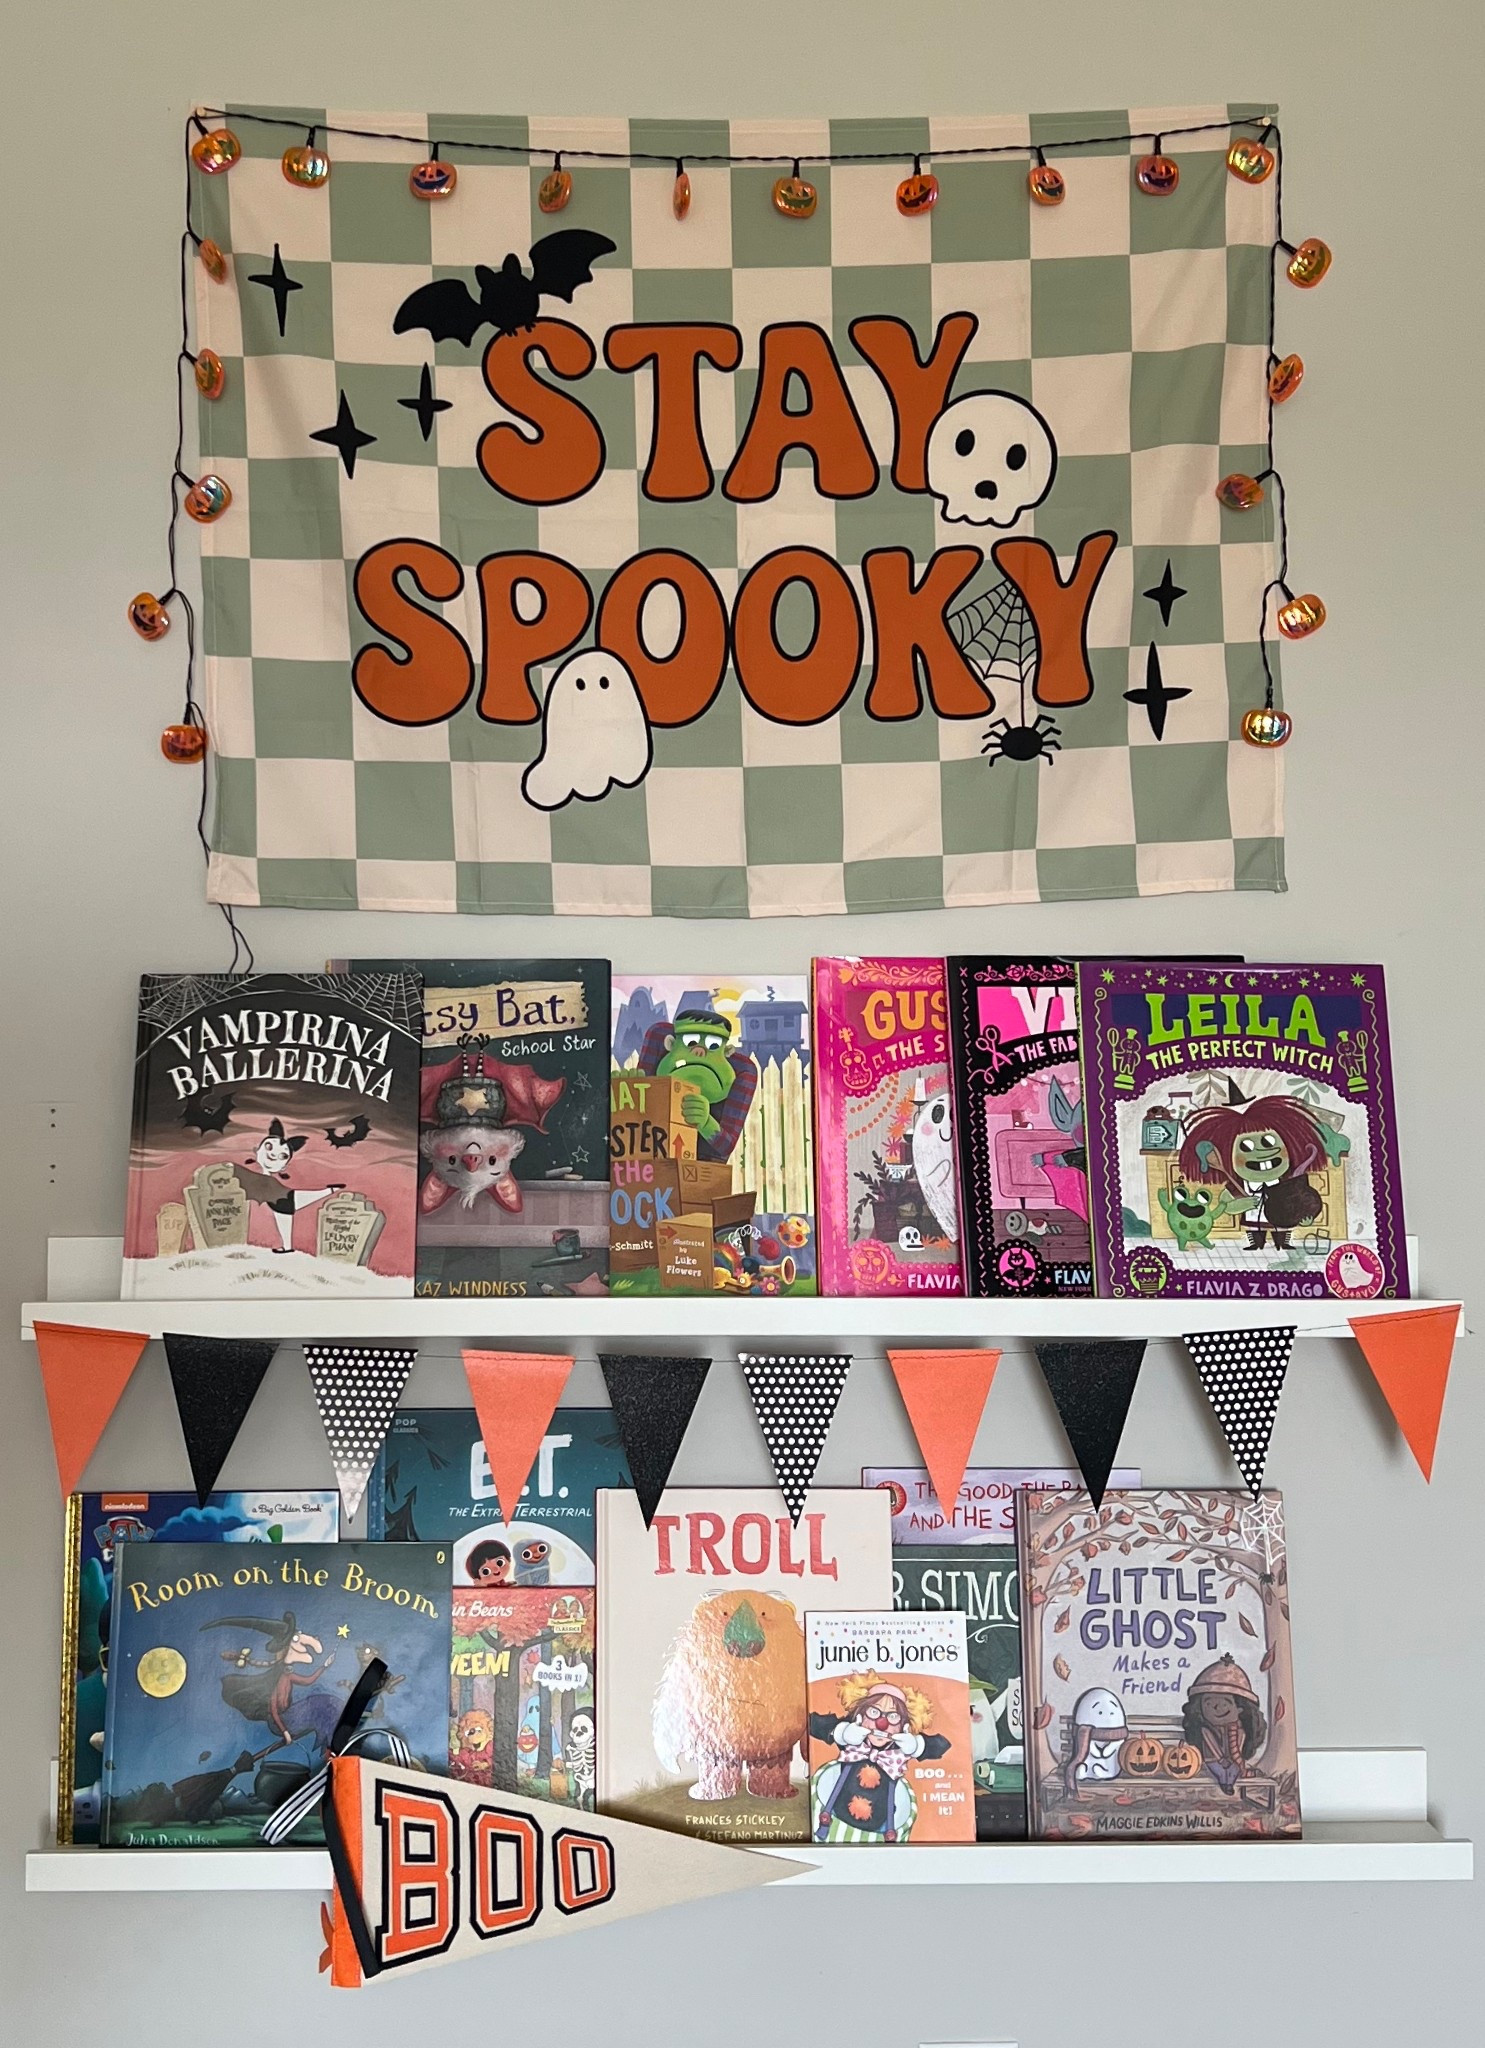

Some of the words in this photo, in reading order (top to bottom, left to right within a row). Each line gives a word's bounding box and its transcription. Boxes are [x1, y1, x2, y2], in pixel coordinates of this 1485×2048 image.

[477, 311, 978, 505] STAY
[352, 530, 1118, 727] SPOOKY
[496, 988, 576, 1028] Bat,
[860, 990, 946, 1040] GUS
[1145, 993, 1326, 1048] LEILA
[168, 1010, 393, 1066] VAMPIRINA
[501, 1037, 556, 1057] School
[562, 1035, 596, 1052] Star
[884, 1035, 925, 1061] THE
[1014, 1041, 1047, 1063] THE
[1048, 1036, 1078, 1054] FAB
[1146, 1045, 1184, 1070] THE
[1187, 1039, 1266, 1062] PERFECT
[1272, 1042, 1334, 1075] WITCH
[167, 1048, 395, 1102] BALLERINA
[610, 1120, 668, 1160] STER
[610, 1187, 676, 1229] OCK
[666, 1265, 702, 1277] Flowers
[675, 1256, 697, 1265] Luke
[907, 1273, 962, 1289] FLAVIA
[1054, 1269, 1091, 1285] FLAV
[448, 1280, 528, 1297] WINDNESS
[1186, 1280, 1245, 1297] FLAVIA
[1248, 1282, 1265, 1297] Z.
[1268, 1281, 1324, 1297] DRAGO
[395, 1418, 417, 1426] POP
[258, 1503, 274, 1516] Big
[274, 1503, 301, 1513] Golden
[302, 1503, 322, 1513] Book
[449, 1507, 471, 1517] THE
[910, 1512, 944, 1531] AND
[952, 1505, 992, 1529] THE
[651, 1511, 838, 1582] TROLL
[127, 1569, 224, 1614] Room
[233, 1565, 274, 1587] on
[280, 1558, 330, 1587] the
[341, 1563, 440, 1620] Broom
[1086, 1567, 1218, 1605] LITTLE
[468, 1600, 514, 1617] Bears
[1079, 1608, 1227, 1651] GHOST
[555, 1660, 563, 1671] 3
[815, 1640, 869, 1670] junie
[875, 1639, 894, 1662] b.
[895, 1640, 958, 1670] jones
[1112, 1651, 1170, 1673] Makes
[1177, 1656, 1191, 1669] a
[538, 1671, 563, 1681] BOOKS
[564, 1673, 573, 1681] IN
[1121, 1673, 1183, 1695] Friend
[922, 1792, 927, 1802] I
[930, 1792, 965, 1802] MEAN
[685, 1814, 732, 1826] FRANCES
[735, 1814, 786, 1827] STICKLEY
[1097, 1816, 1144, 1832] MAGGIE
[1146, 1815, 1184, 1829] EDKINS
[1186, 1814, 1223, 1829] WILLIS
[127, 1832, 156, 1847] Julia
[704, 1830, 751, 1840] STEFANO
[754, 1830, 804, 1840] MARTINUZ
[375, 1778, 616, 1970] BOO
